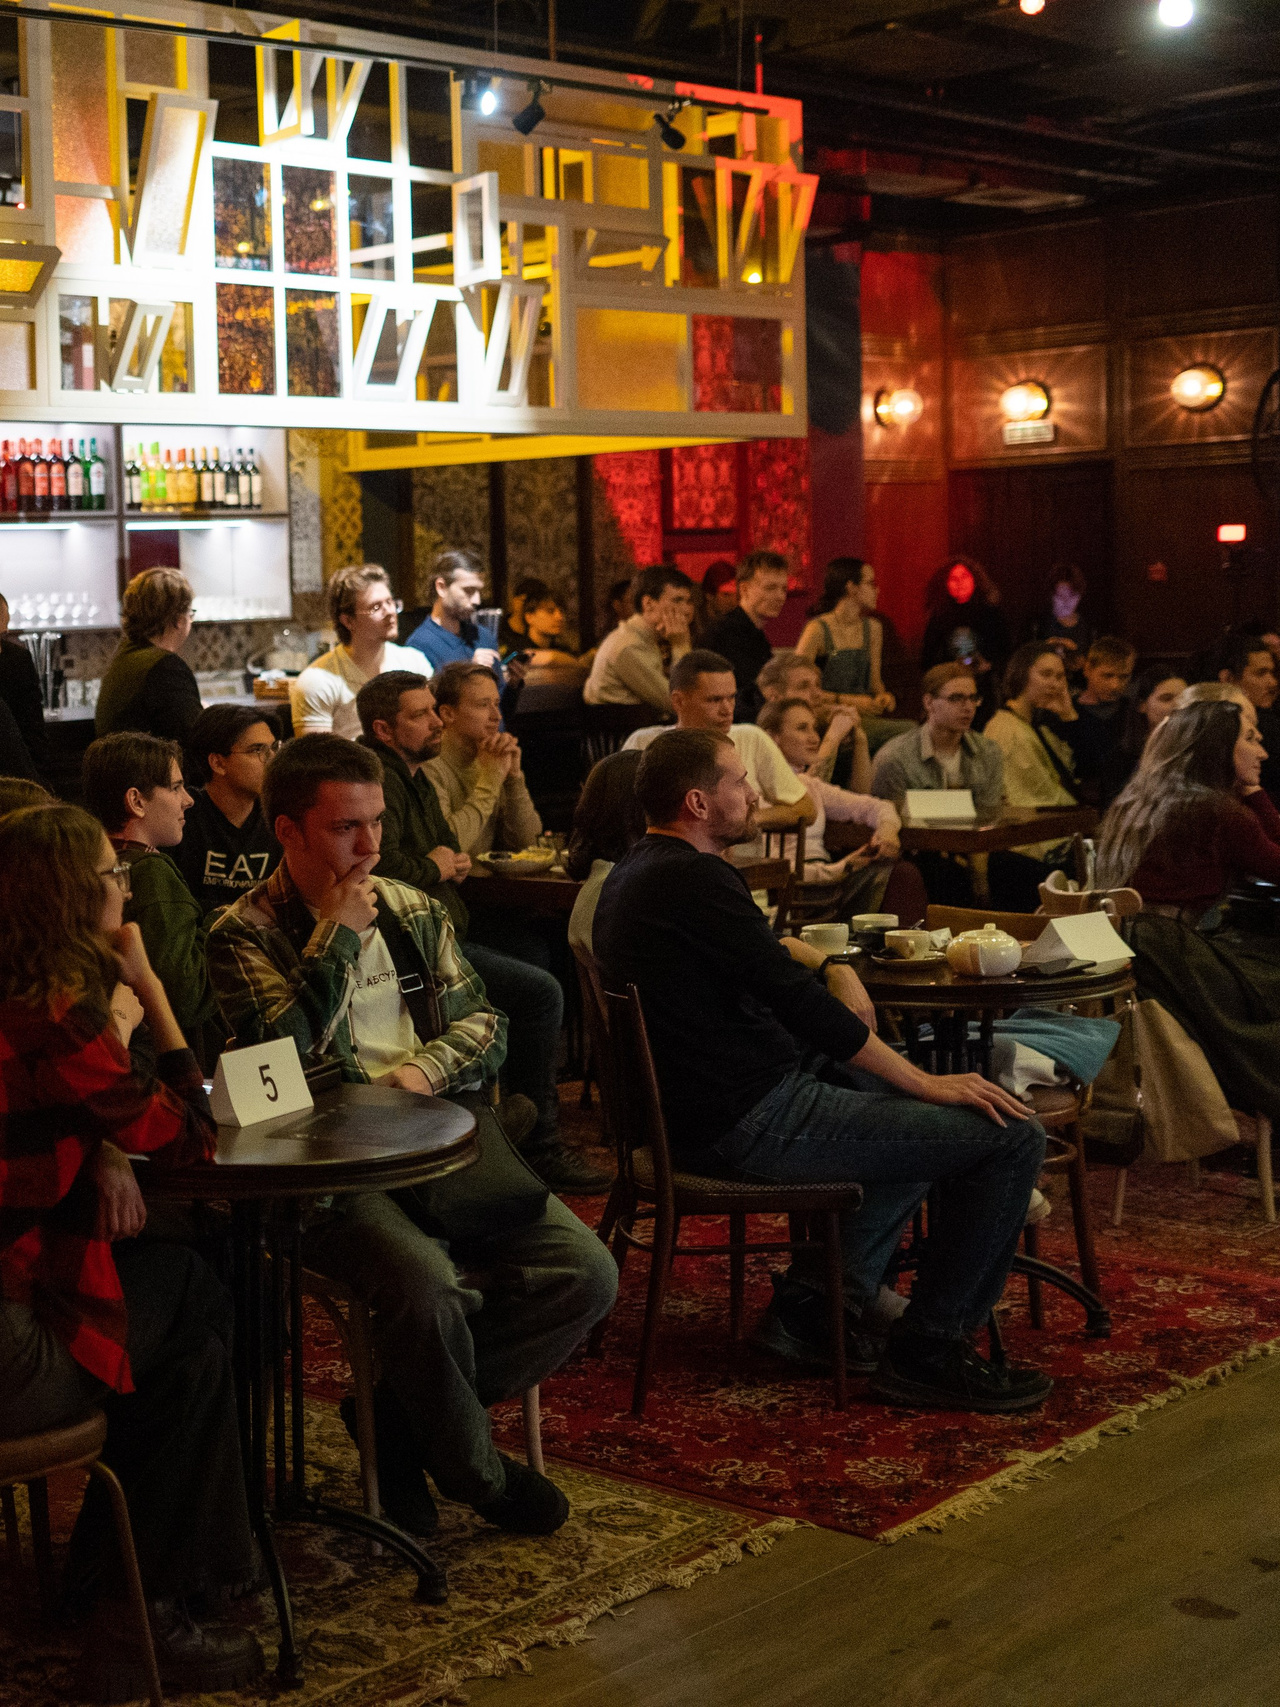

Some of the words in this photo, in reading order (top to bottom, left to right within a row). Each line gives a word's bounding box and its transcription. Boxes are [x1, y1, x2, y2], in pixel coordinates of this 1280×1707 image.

[205, 850, 269, 879] EA7
[366, 969, 396, 987] АБСУР
[258, 1063, 279, 1102] 5
